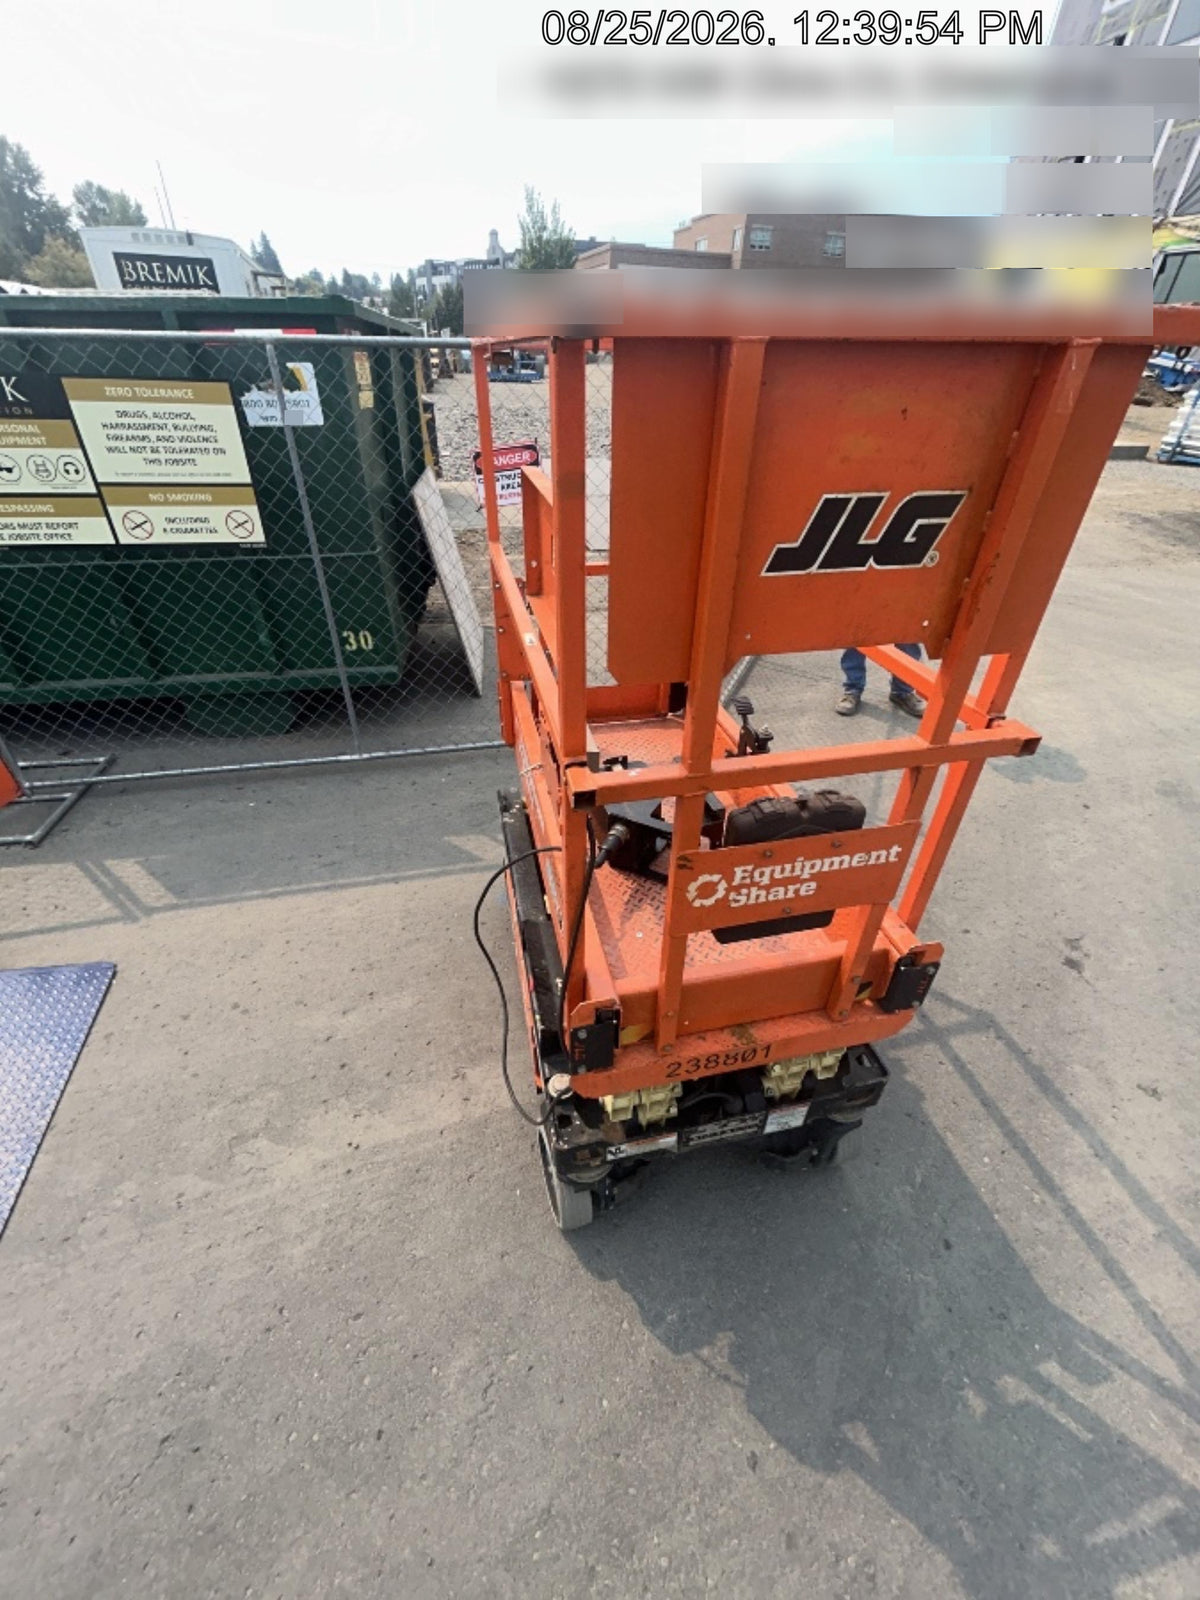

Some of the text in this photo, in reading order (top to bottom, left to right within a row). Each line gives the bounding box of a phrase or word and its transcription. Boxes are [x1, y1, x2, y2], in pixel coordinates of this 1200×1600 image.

[121, 260, 213, 285] BREMIK
[104, 387, 194, 399] ZERO TOLERANCE
[177, 435, 219, 443] VIOLENCE
[105, 446, 128, 454] WILL
[129, 446, 148, 454] NOT
[493, 452, 531, 465] ANGER
[149, 494, 212, 502] NO SMOKING
[17, 522, 43, 531] MUST
[45, 522, 79, 531] REPORT
[761, 490, 968, 576] JLG
[43, 533, 73, 541] OFFICE
[342, 630, 374, 652] 30
[731, 844, 902, 888] Equipment
[728, 881, 817, 908] Share
[665, 1044, 772, 1079] 238801
